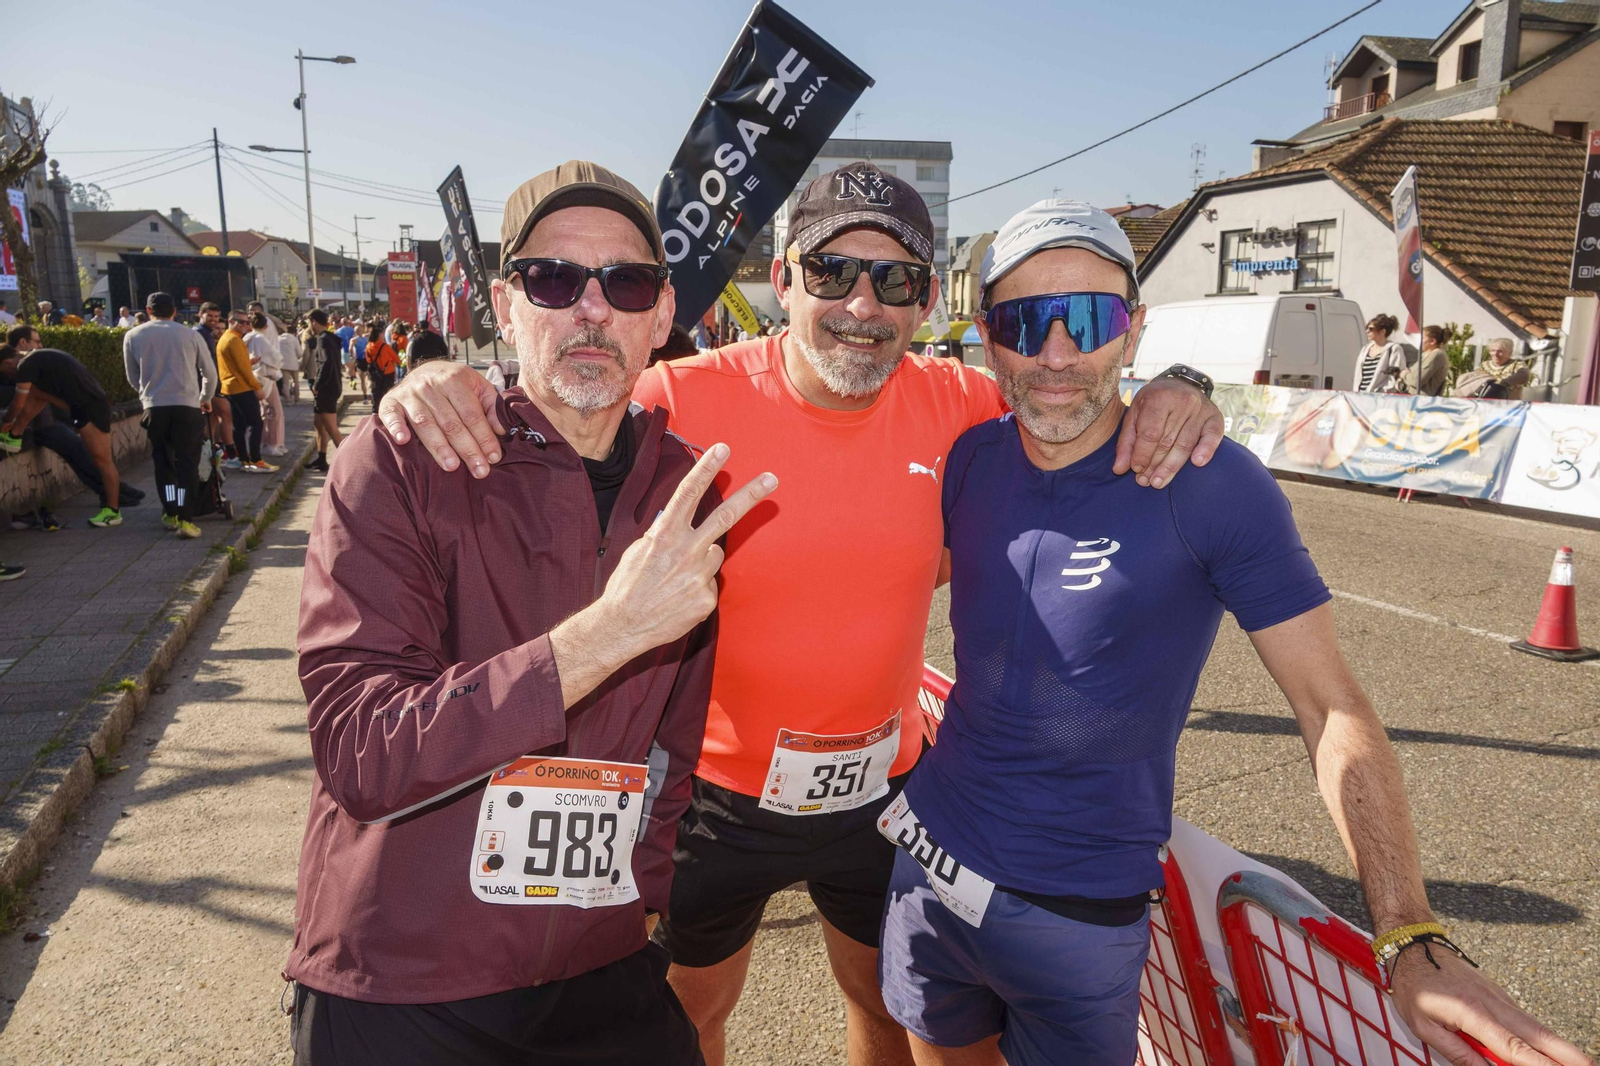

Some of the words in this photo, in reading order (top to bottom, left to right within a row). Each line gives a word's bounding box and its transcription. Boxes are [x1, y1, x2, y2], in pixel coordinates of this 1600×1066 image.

[784, 76, 829, 130] DACIA
[836, 171, 893, 206] NY
[662, 119, 770, 275] ODOSA
[698, 174, 760, 270] ALPINE
[1232, 256, 1299, 276] imprenta
[1364, 449, 1409, 462] Grandioso
[1411, 453, 1440, 466] sabor.
[1406, 465, 1416, 474] el
[1417, 466, 1444, 479] gusto
[823, 737, 865, 748] PORRIÑO
[832, 751, 863, 762] SANTI
[548, 766, 599, 781] PORRIÑO
[806, 757, 872, 800] 351
[555, 793, 607, 807] SCOMVRO
[771, 801, 794, 811] LASAL
[523, 810, 617, 879] 983
[489, 885, 519, 895] LASAL
[526, 886, 558, 896] GADIS
